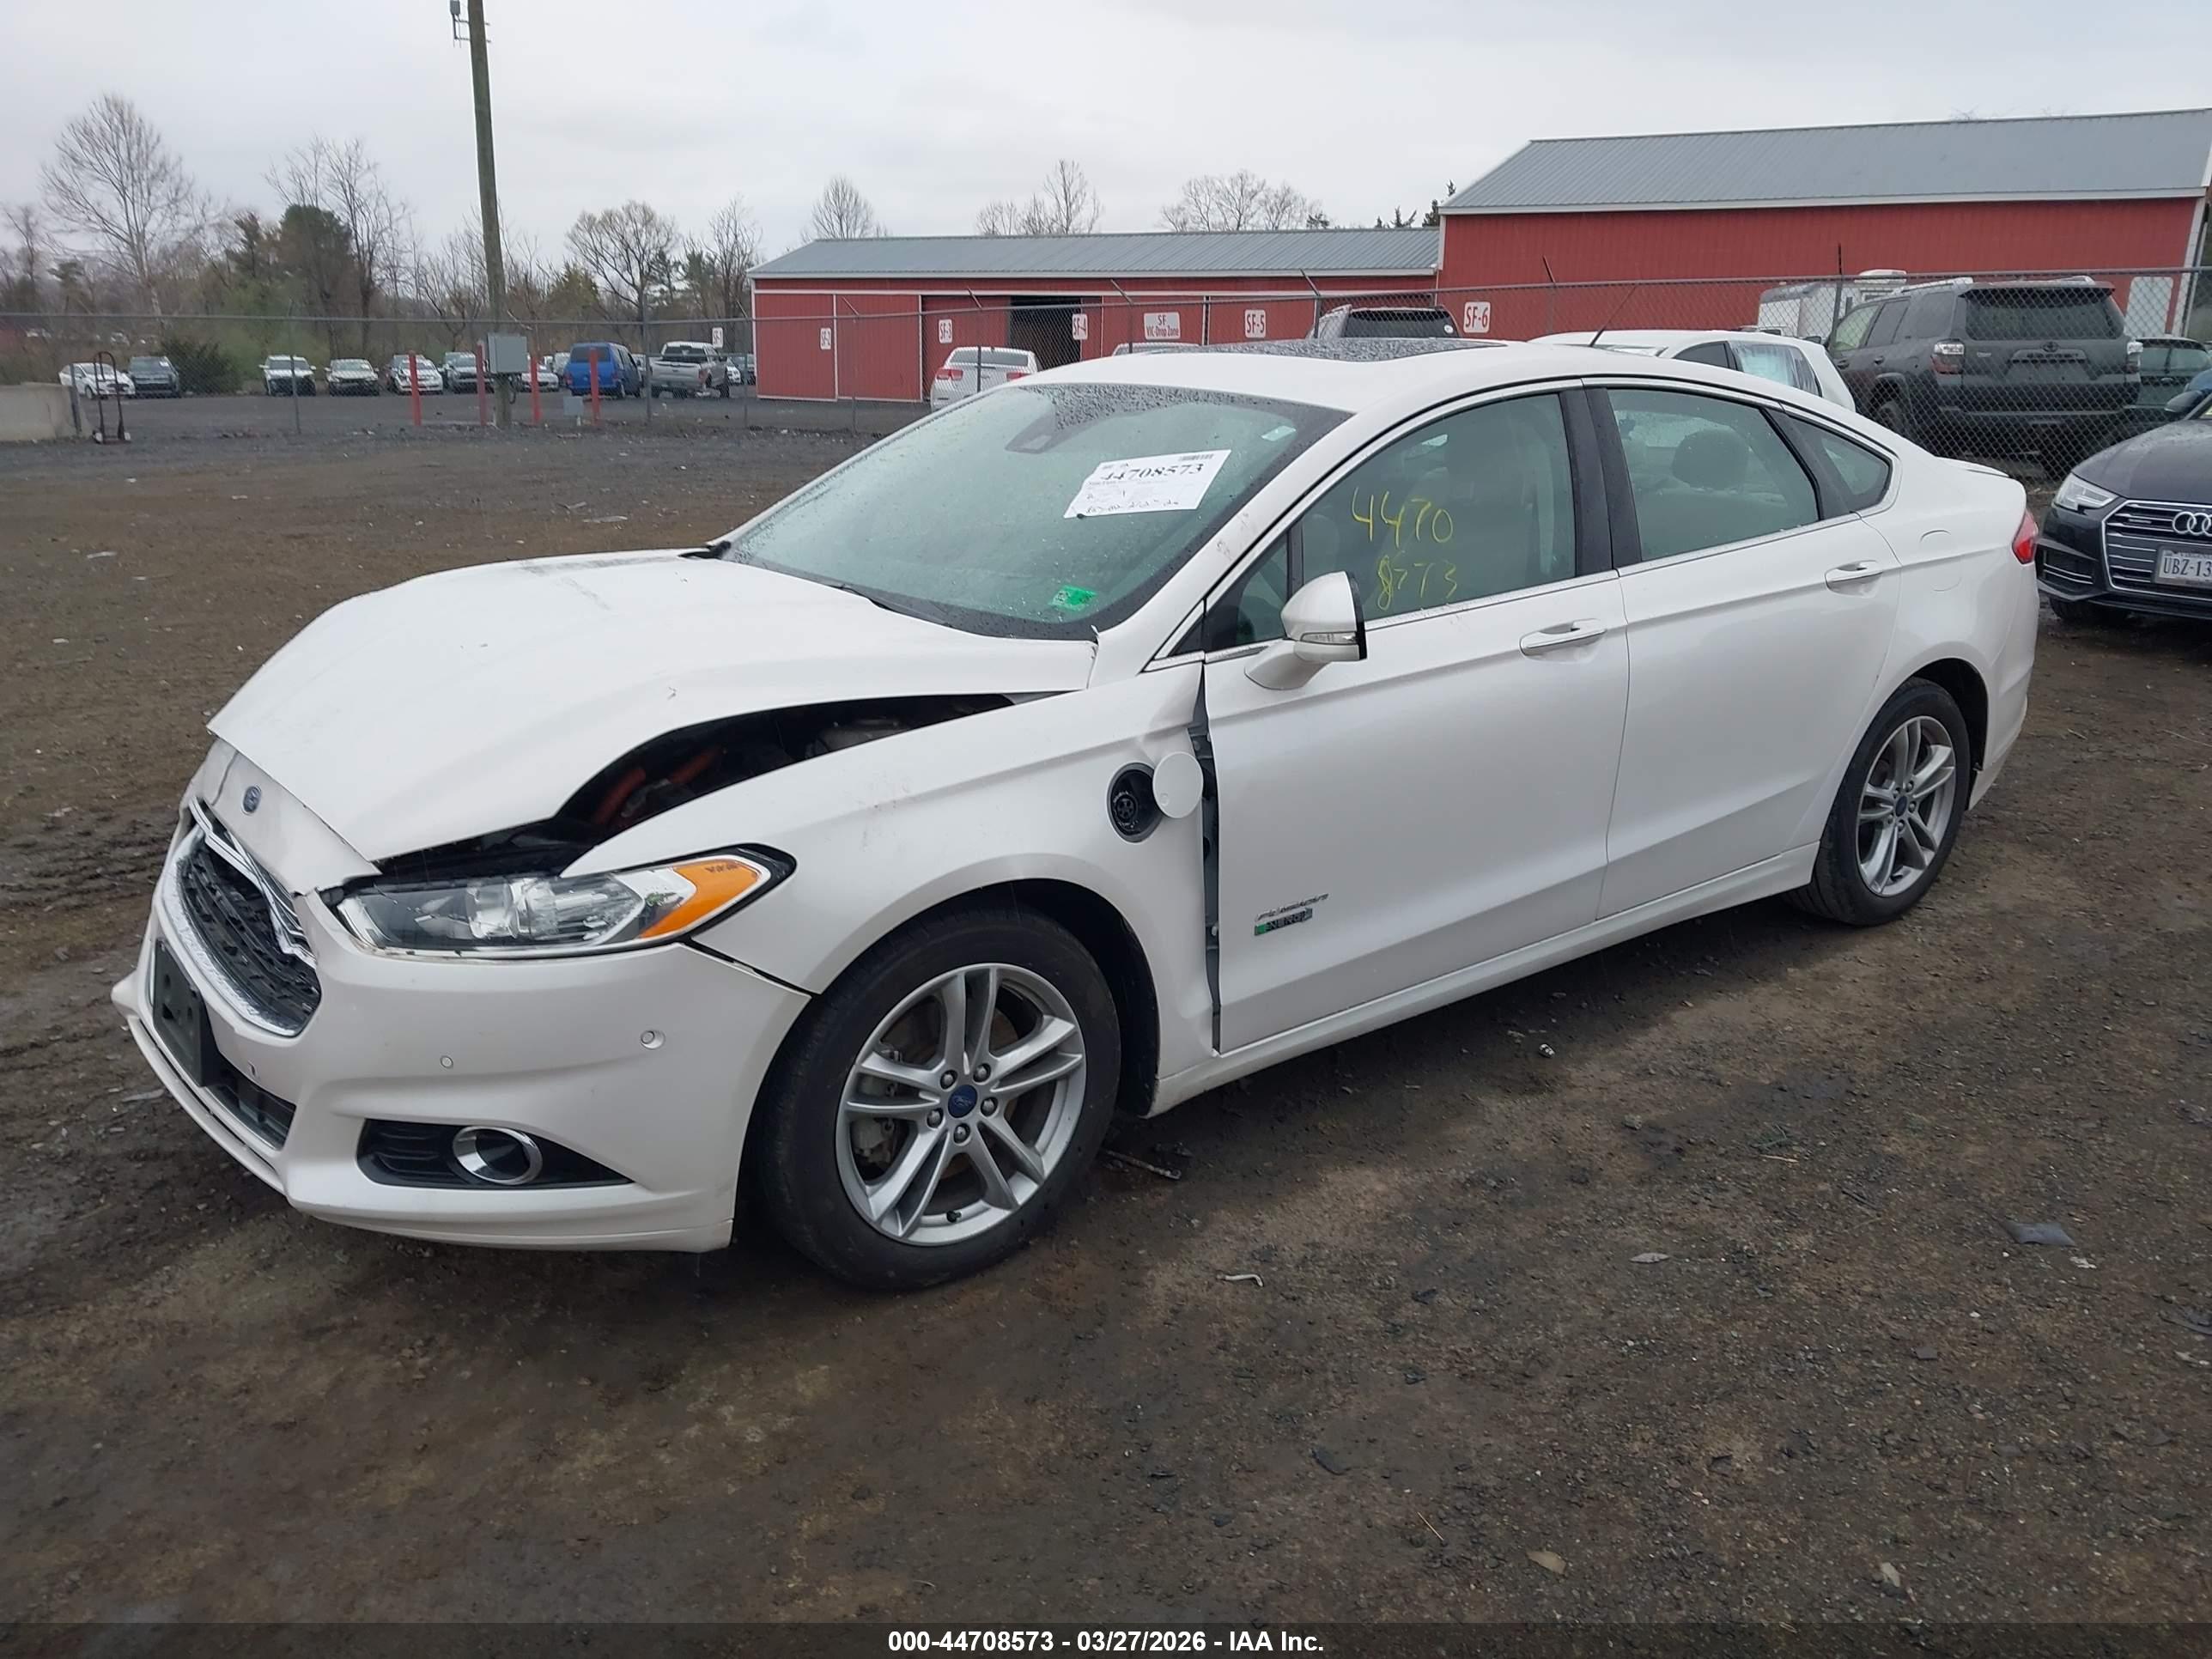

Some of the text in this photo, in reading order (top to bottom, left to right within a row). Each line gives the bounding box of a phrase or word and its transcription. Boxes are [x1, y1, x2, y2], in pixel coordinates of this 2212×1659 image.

[1073, 317, 1086, 336] SF-4
[1158, 314, 1167, 325] SF
[1246, 313, 1265, 333] SF-5
[1465, 306, 1489, 328] SF-6
[939, 322, 951, 339] SF-3
[1352, 487, 1454, 548] 4470
